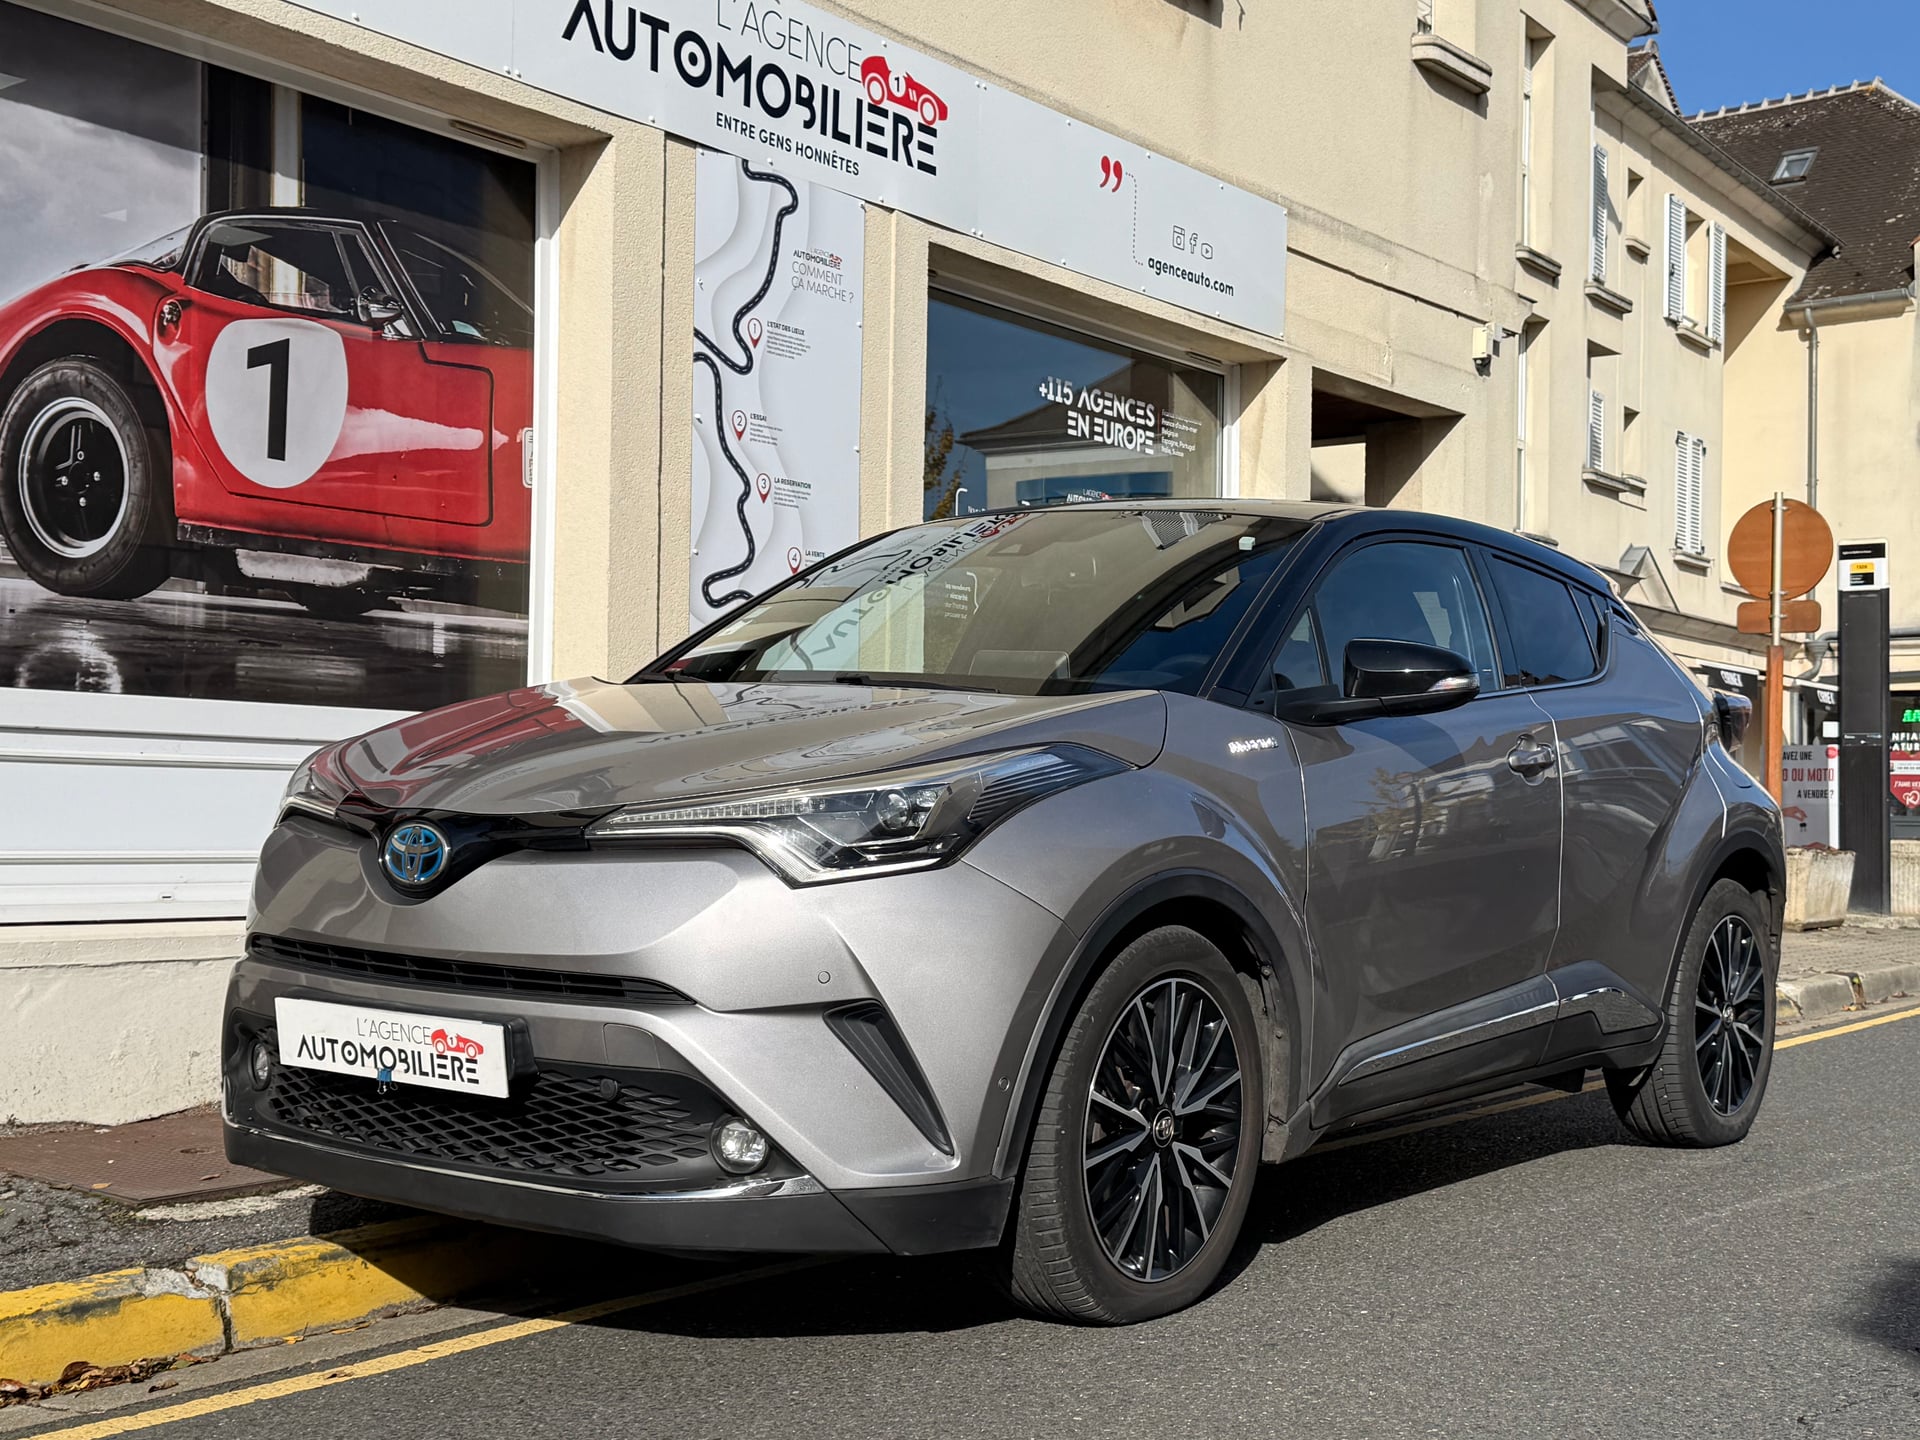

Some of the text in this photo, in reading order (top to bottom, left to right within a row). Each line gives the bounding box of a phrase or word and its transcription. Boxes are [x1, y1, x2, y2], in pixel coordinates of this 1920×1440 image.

[717, 0, 862, 84] LAGENCE
[716, 111, 860, 176] ENTRE GENS HONNÊTES
[792, 261, 844, 286] COMMENT
[1147, 256, 1235, 297] agenceauto.com
[791, 276, 855, 303] ÇA MARCHE ?
[246, 338, 290, 462] 1
[1039, 376, 1073, 406] +115
[1077, 385, 1155, 427] AGENCES
[736, 415, 743, 426] 2
[1067, 410, 1090, 439] EN
[1093, 417, 1155, 455] EUROPE
[761, 478, 767, 489] 3
[792, 553, 797, 562] 4
[1800, 751, 1813, 760] UNE
[1791, 768, 1804, 782] OU
[1807, 768, 1834, 782] MOTO
[1803, 788, 1828, 798] VENDRE
[356, 1017, 432, 1045] L'AGENCE
[297, 1034, 479, 1084] AUTOMOBILIERE
